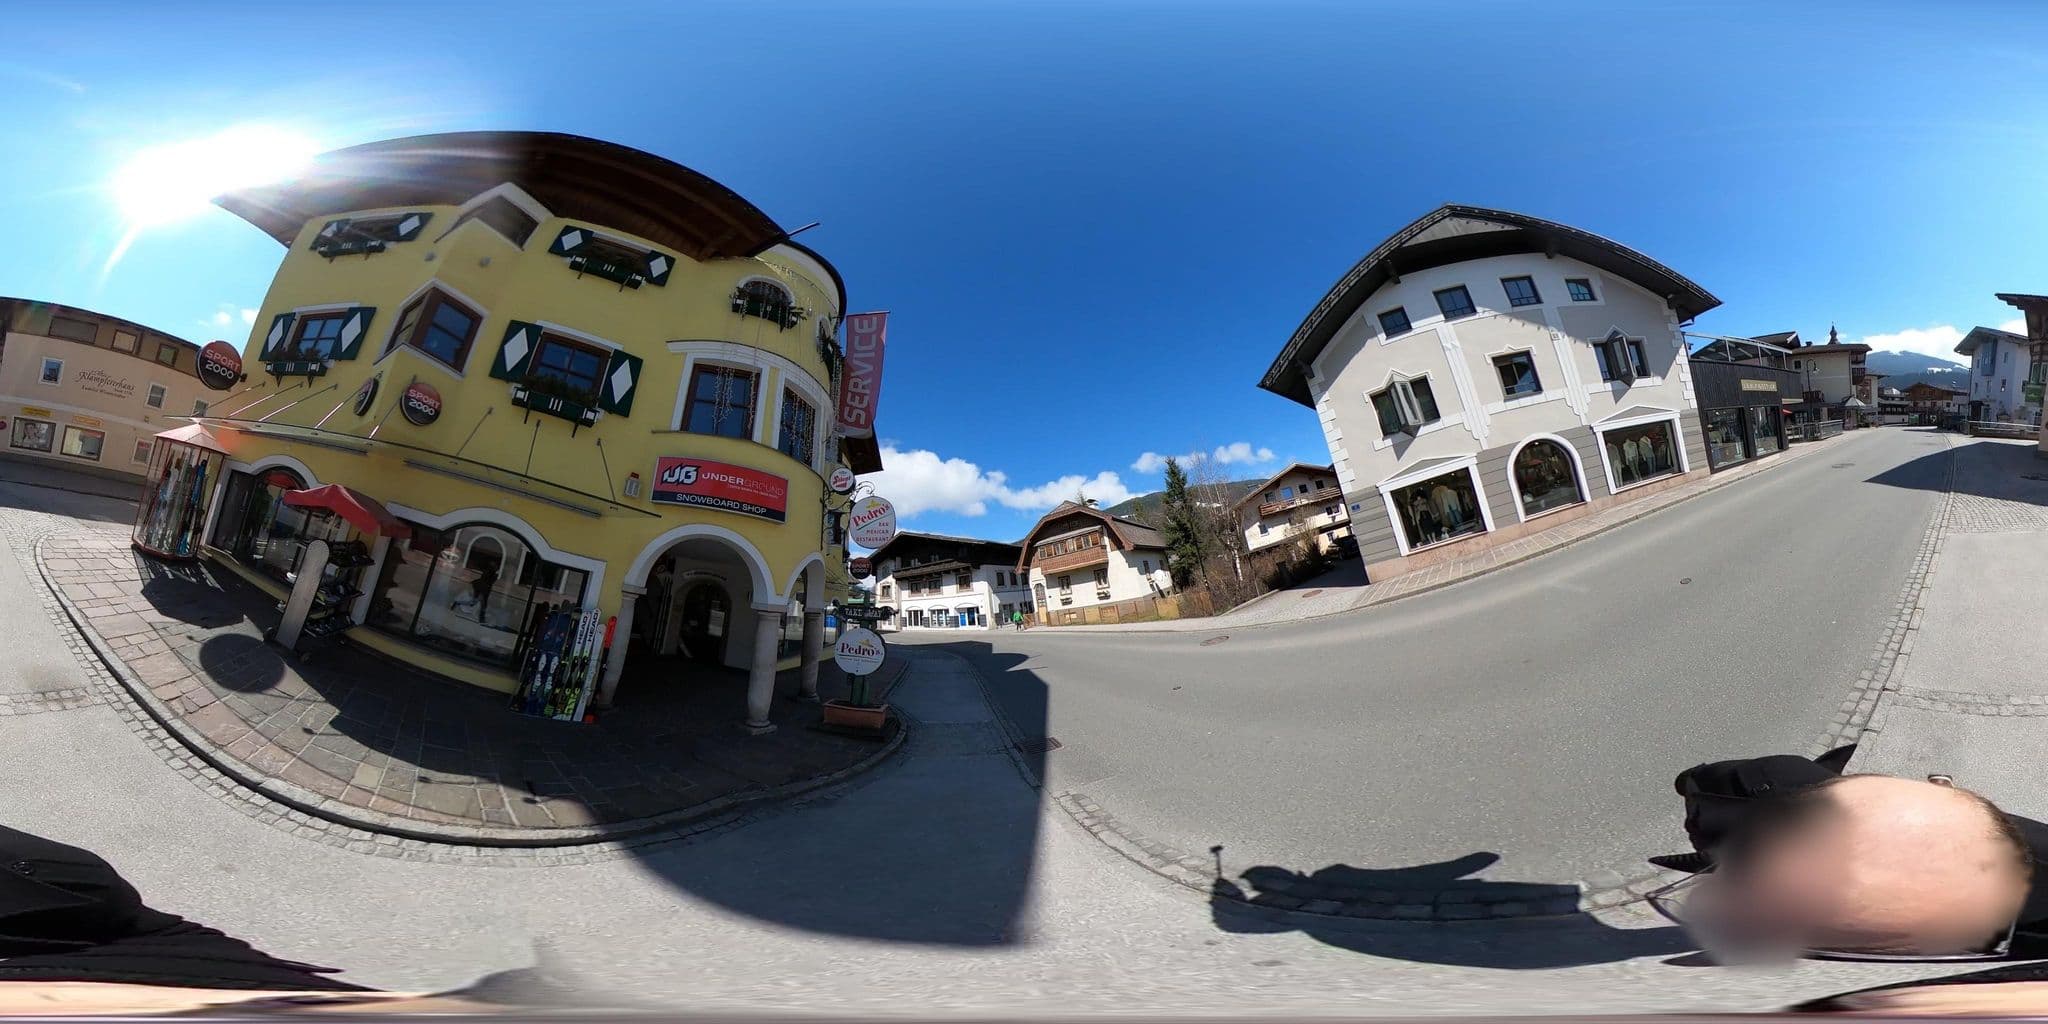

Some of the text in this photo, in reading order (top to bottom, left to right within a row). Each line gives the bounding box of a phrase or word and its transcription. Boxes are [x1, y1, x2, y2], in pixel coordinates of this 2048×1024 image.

[205, 349, 240, 371] SPORT
[205, 360, 234, 379] 2000
[844, 317, 877, 425] SERVICE
[408, 389, 440, 409] SPORT
[408, 399, 435, 416] 2000
[676, 493, 767, 515] SNOWBOARD SHOP
[852, 503, 891, 528] Pedro's
[844, 608, 863, 617] TAKE
[578, 615, 588, 645] HEAD
[588, 613, 599, 642] HEAD
[841, 642, 881, 657] Pedro's
